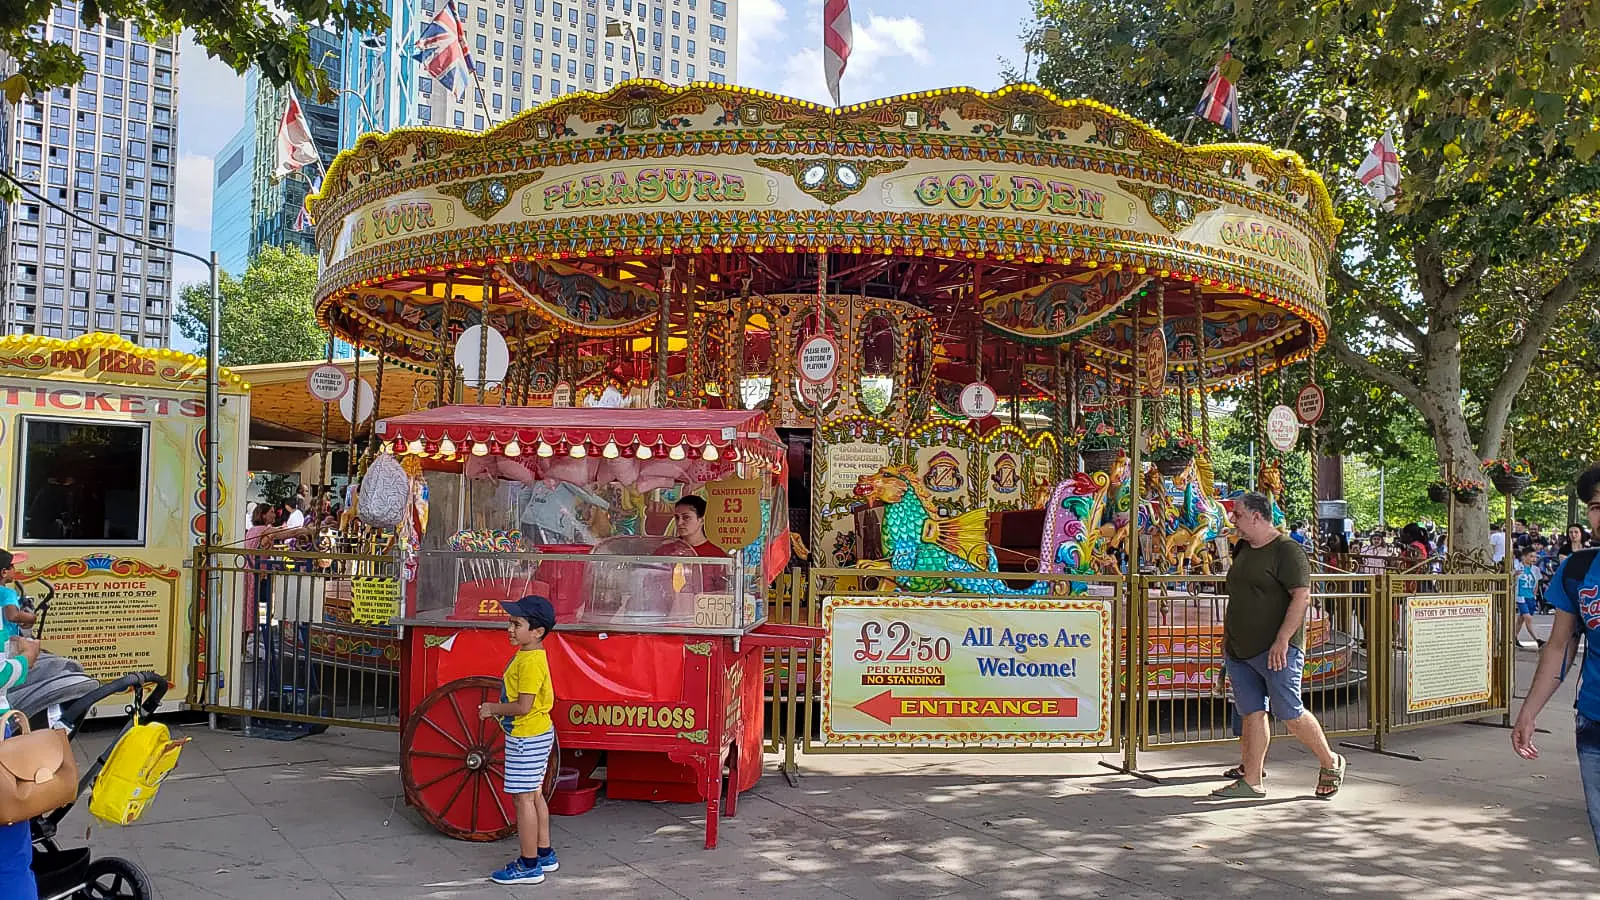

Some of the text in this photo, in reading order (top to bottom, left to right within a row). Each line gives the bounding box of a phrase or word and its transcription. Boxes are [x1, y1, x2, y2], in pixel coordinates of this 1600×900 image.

[544, 168, 746, 210] PLEASURE
[916, 174, 1105, 220] GOLDEN
[371, 202, 436, 239] YOUR
[50, 347, 157, 376] PAY HERE
[0, 385, 206, 417] TICKETS
[712, 488, 756, 496] CANDYFLOSS
[723, 498, 743, 513] £3
[54, 582, 147, 591] SAFETY NOTICE
[697, 597, 732, 611] CASH
[1414, 608, 1437, 617] HISTORY
[1448, 608, 1457, 616] THE
[1459, 606, 1485, 615] CAROUSEL
[695, 611, 731, 626] ONLY
[962, 627, 1091, 653] All Ages Are
[867, 666, 942, 675] PER PERSON
[977, 657, 1077, 678] Welcome!
[867, 675, 941, 685] NO STANDING
[900, 700, 1060, 716] ENTRANCE
[568, 703, 696, 730] CANDYFLOSS
